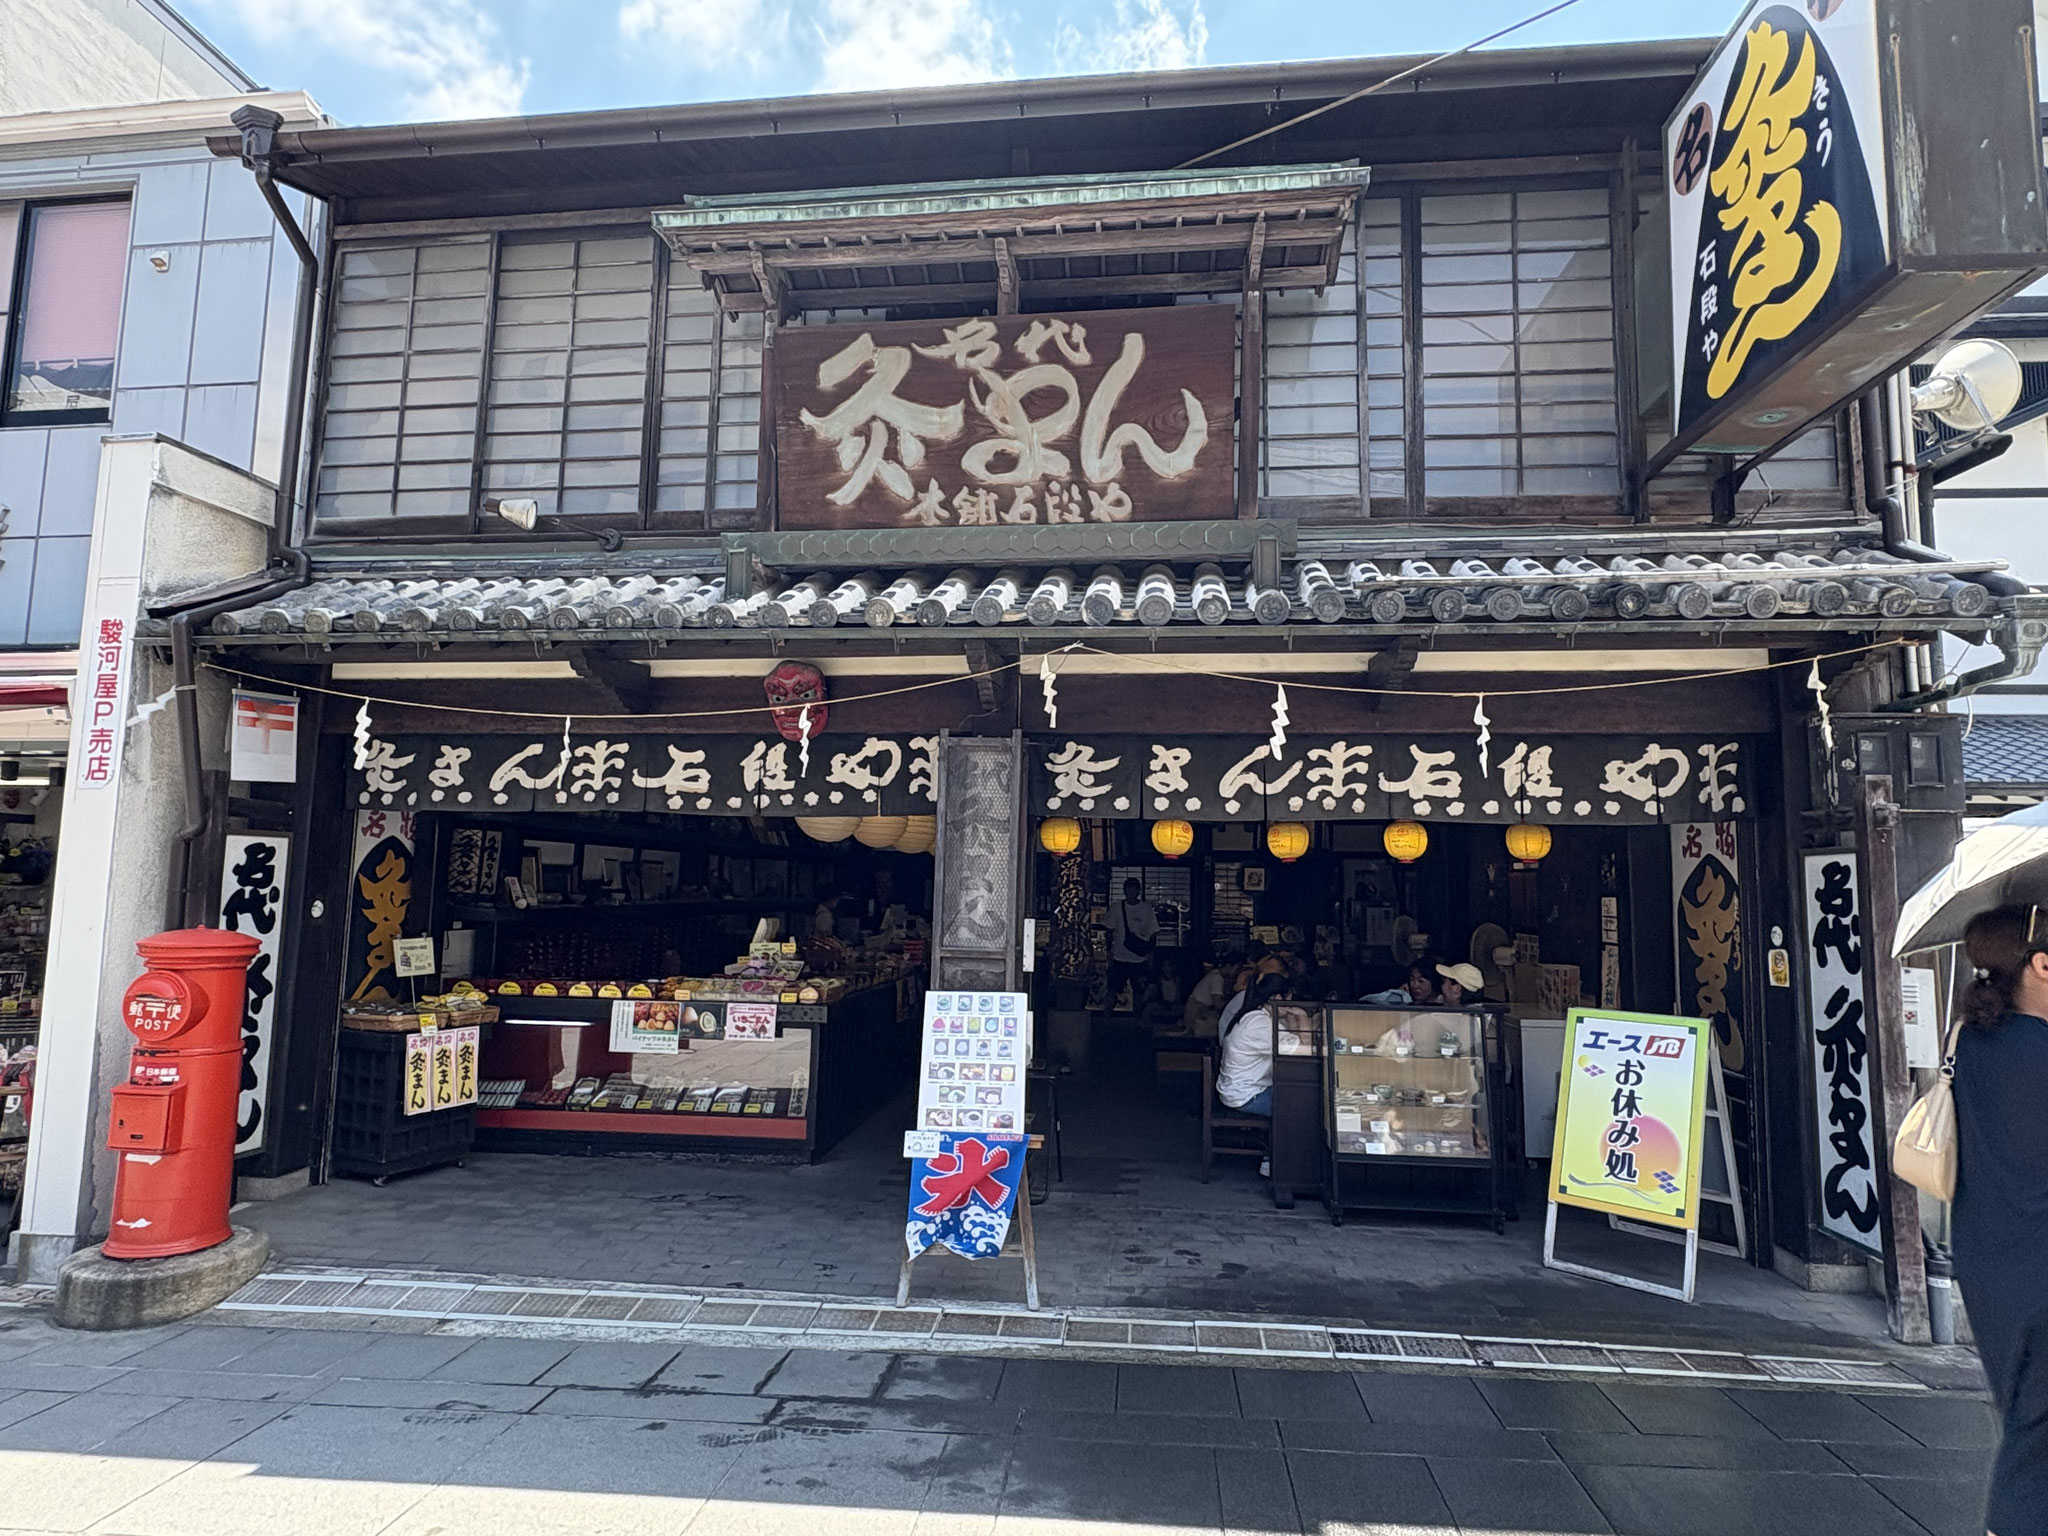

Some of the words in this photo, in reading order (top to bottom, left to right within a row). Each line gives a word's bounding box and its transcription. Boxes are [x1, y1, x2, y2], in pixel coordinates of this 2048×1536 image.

[1812, 75, 1833, 167] きう
[1699, 239, 1719, 362] 石段や
[84, 618, 124, 782] 駿河屋P売店
[134, 1018, 171, 1032] POST
[1583, 1030, 1642, 1054] エース
[1647, 1035, 1683, 1057] JTB
[410, 1051, 425, 1109] 灸まん
[435, 1048, 451, 1104] 灸まん
[459, 1044, 473, 1099] 灸まん
[1603, 1058, 1646, 1184] お休み処
